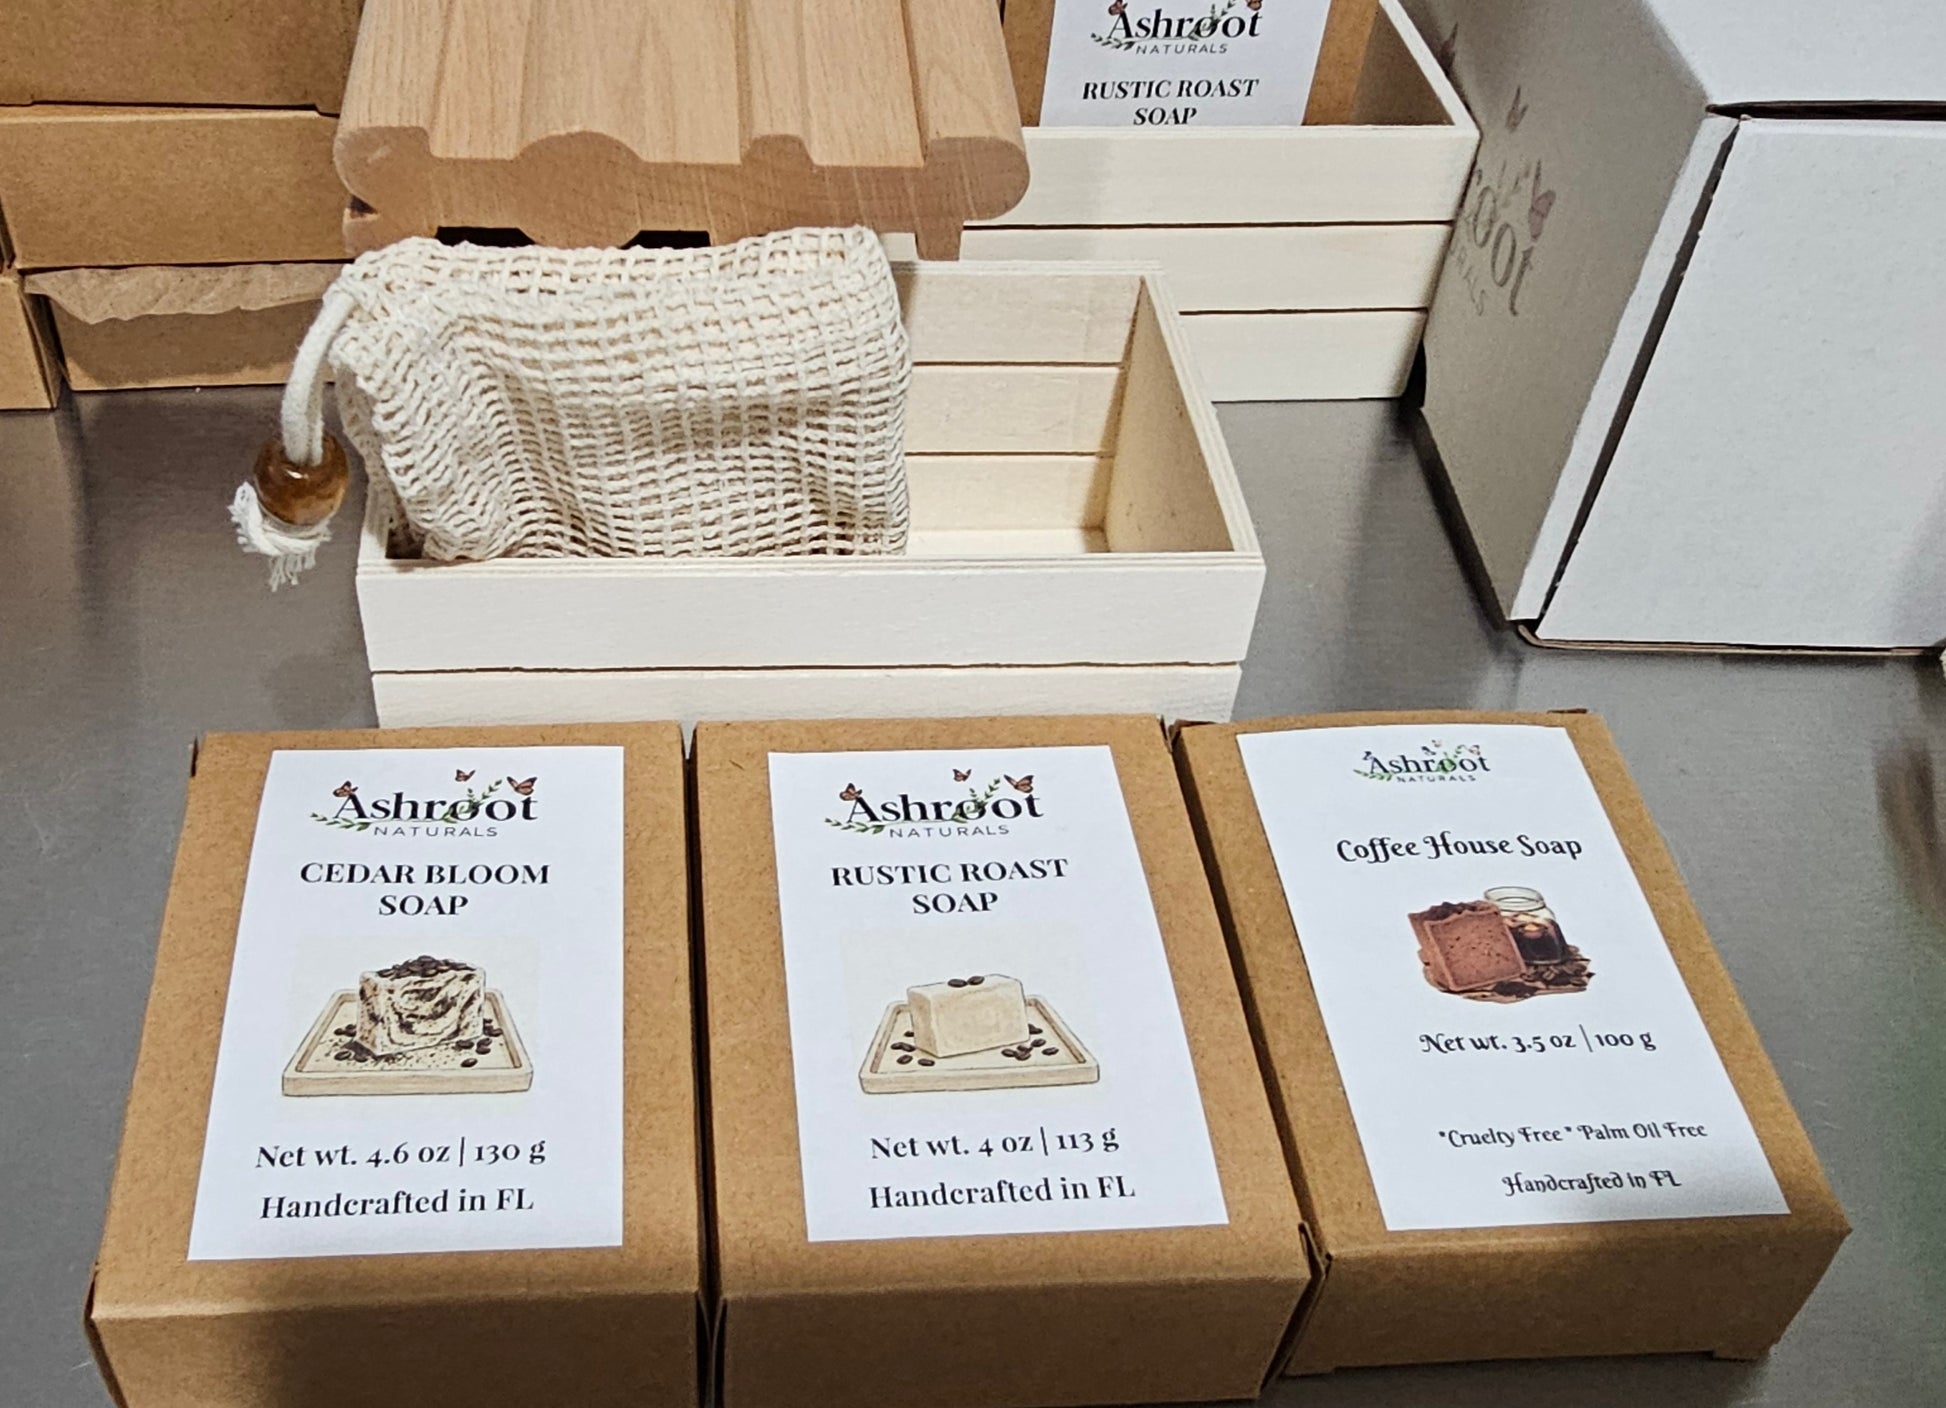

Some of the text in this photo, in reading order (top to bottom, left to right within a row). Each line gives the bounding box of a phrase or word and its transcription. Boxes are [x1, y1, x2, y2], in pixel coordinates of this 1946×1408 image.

[1107, 8, 1262, 39] Ashroot
[1136, 43, 1228, 54] NATURALS
[1083, 79, 1259, 99] RUSTIC ROAST
[1133, 108, 1197, 125] SOAP
[1369, 755, 1491, 774] Ashroot
[1396, 774, 1476, 783] NATURALS
[333, 792, 539, 822] Ashroot
[848, 793, 1044, 823] Ashroot
[374, 825, 498, 837] NATURALS
[889, 824, 1009, 838] NATURALS
[1337, 831, 1582, 864] Coffee House Soap
[301, 863, 548, 884] CEDAR BLOOM
[832, 859, 1067, 886] RUSTIC ROAST
[379, 895, 468, 915] SOAP
[913, 893, 997, 914] SOAP
[1419, 1033, 1465, 1053] Net
[1469, 1036, 1507, 1050] wt.
[1512, 1036, 1546, 1053] 3.5
[1550, 1036, 1576, 1047] oz
[1595, 1034, 1634, 1046] 100
[1640, 1032, 1656, 1051] g
[1633, 1122, 1661, 1138] Oil
[1663, 1122, 1707, 1138] Free
[871, 1138, 919, 1158] Net
[926, 1136, 969, 1156] wt.
[979, 1139, 993, 1157] 4
[1002, 1137, 1033, 1152] oz
[1057, 1133, 1094, 1152] 113
[1102, 1128, 1119, 1152] g
[256, 1146, 304, 1167] Net
[315, 1146, 356, 1165] wt.
[366, 1142, 409, 1168] 4.6
[419, 1146, 450, 1162] oz
[476, 1145, 520, 1164] 130
[530, 1141, 545, 1164] g
[870, 1176, 1135, 1208] Handcrafted in FL
[1502, 1170, 1682, 1196] Handcrafted in FL
[261, 1189, 533, 1218] Handcrafted in FL
